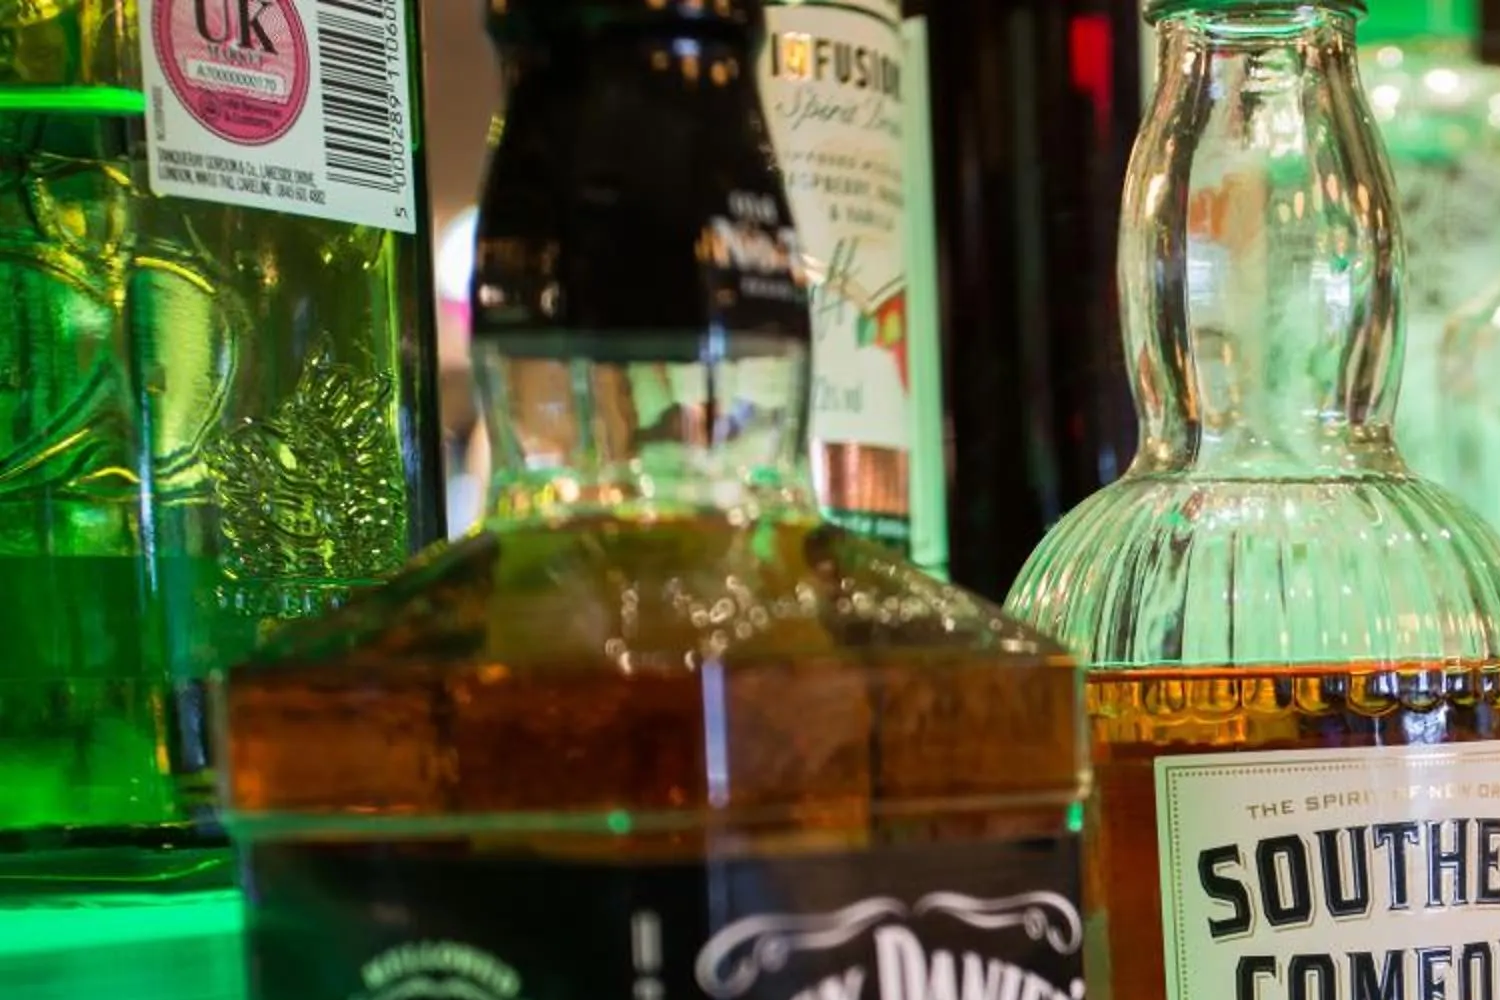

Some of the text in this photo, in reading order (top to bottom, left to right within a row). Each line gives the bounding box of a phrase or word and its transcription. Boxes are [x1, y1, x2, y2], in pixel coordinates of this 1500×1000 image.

[195, 0, 278, 55] UK
[396, 207, 408, 219] 5
[1246, 799, 1294, 820] THE
[1305, 787, 1375, 812] SPIRI
